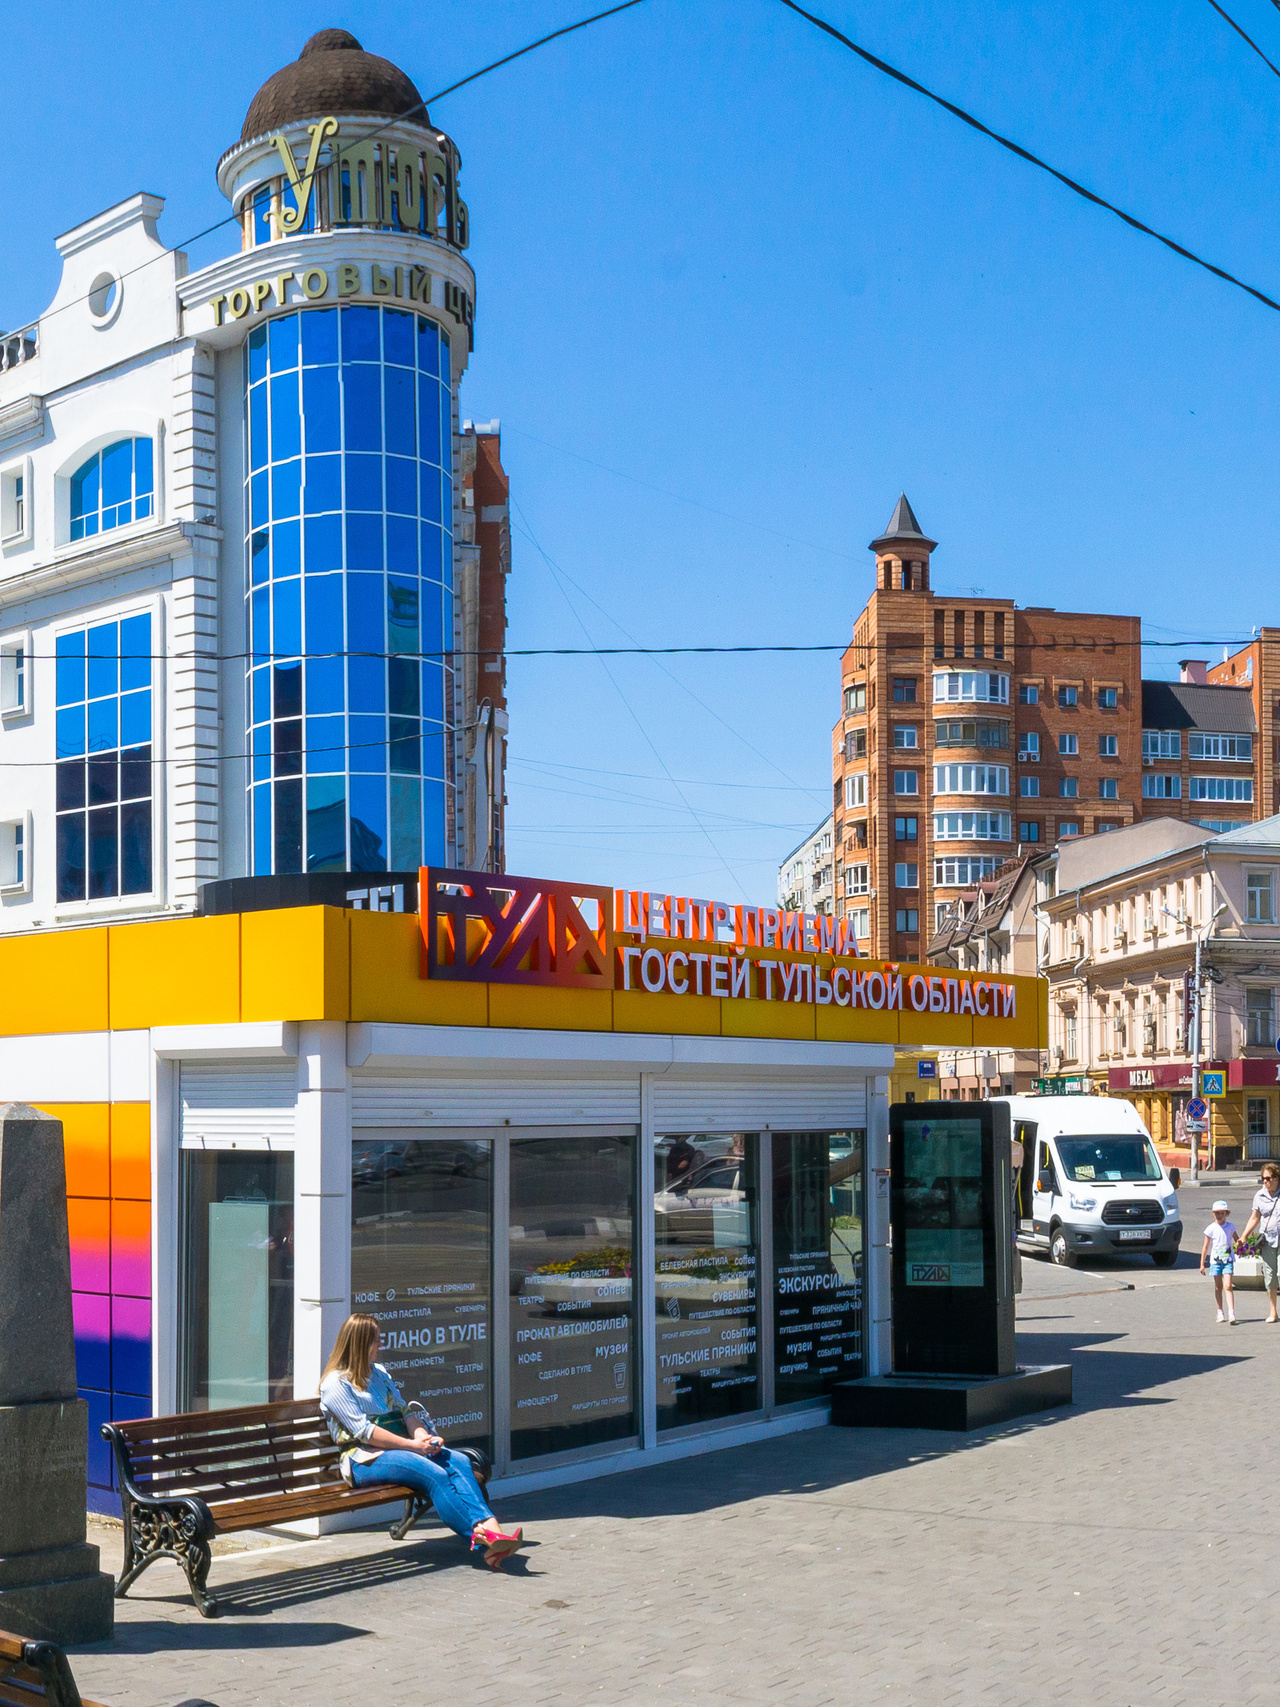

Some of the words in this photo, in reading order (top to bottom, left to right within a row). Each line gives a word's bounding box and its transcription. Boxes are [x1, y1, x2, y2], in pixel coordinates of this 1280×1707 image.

[209, 264, 432, 326] ТОРГОВЫЙ
[621, 889, 730, 943] ЦЕНТР
[739, 905, 860, 957] ПРИЕМА
[623, 946, 750, 998] ГОСТЕЙ
[759, 960, 903, 1010] ТУЛЬСКОЙ
[911, 974, 1017, 1018] ОБЛАСТИ
[1129, 1070, 1155, 1086] МЕХА
[660, 1259, 698, 1271] БЕЛЕВСКАЯ
[698, 1256, 729, 1268] ПАСТИЛА
[734, 1253, 756, 1266] coffee
[570, 1271, 580, 1280] ПО
[580, 1268, 610, 1279] ОБЛАСТИ
[719, 1269, 756, 1281] ЭКСКУРСИИ
[407, 1285, 442, 1296] ТУЛЬСКИЕ
[443, 1283, 475, 1293] ПРЯНИКИ
[597, 1282, 627, 1297] coffee
[778, 1273, 846, 1294] ЭКСКУРСИИ
[355, 1292, 380, 1303] КОФЕ
[518, 1295, 545, 1305] ТЕАТРЫ
[712, 1287, 756, 1303] СУВЕНИРЫ
[398, 1307, 432, 1318] ПАСТИЛА
[454, 1304, 486, 1313] СУВЕНИРЫ
[557, 1299, 592, 1312] СОБЫТИЯ
[688, 1308, 725, 1320] ПУТЕШЕСТВИЕ
[725, 1307, 733, 1315] ПО
[733, 1305, 756, 1315] ОБЛАСТИ
[812, 1300, 850, 1315] ПРЯНИЧНЫЙ
[516, 1326, 556, 1342] ПРОКАТ
[556, 1314, 628, 1337] АВТОМОБИЛЕЙ
[721, 1326, 756, 1340] СОБЫТИЯ
[779, 1323, 814, 1335] ПУТЕШЕСТВИЕ
[813, 1322, 820, 1330] ПО
[820, 1319, 843, 1329] ОБЛАСТИ
[378, 1328, 432, 1350] ЕЛАНО
[435, 1327, 446, 1344] В
[448, 1323, 487, 1342] ТУЛЕ
[595, 1343, 628, 1359] музеи
[660, 1348, 710, 1368] ТУЛЬСКИЕ
[711, 1341, 756, 1360] ПРЯНИКИ
[786, 1341, 813, 1356] музеи
[816, 1346, 842, 1358] СОБЫТИЯ
[409, 1356, 445, 1368] КОНФЕТЫ
[518, 1351, 543, 1364] КОФЕ
[455, 1362, 484, 1374] ТЕАТРЫ
[538, 1367, 570, 1380] СДЕЛАНО
[570, 1366, 576, 1375] В
[576, 1364, 592, 1374] ТУЛЕ
[700, 1367, 720, 1377] ТЕАТРЫ
[419, 1387, 452, 1397] МАРШРУТЫ
[462, 1383, 485, 1393] ГОРОДУ
[517, 1393, 559, 1408] ИНФОЦЕНТР
[431, 1410, 483, 1429] cappuccino
